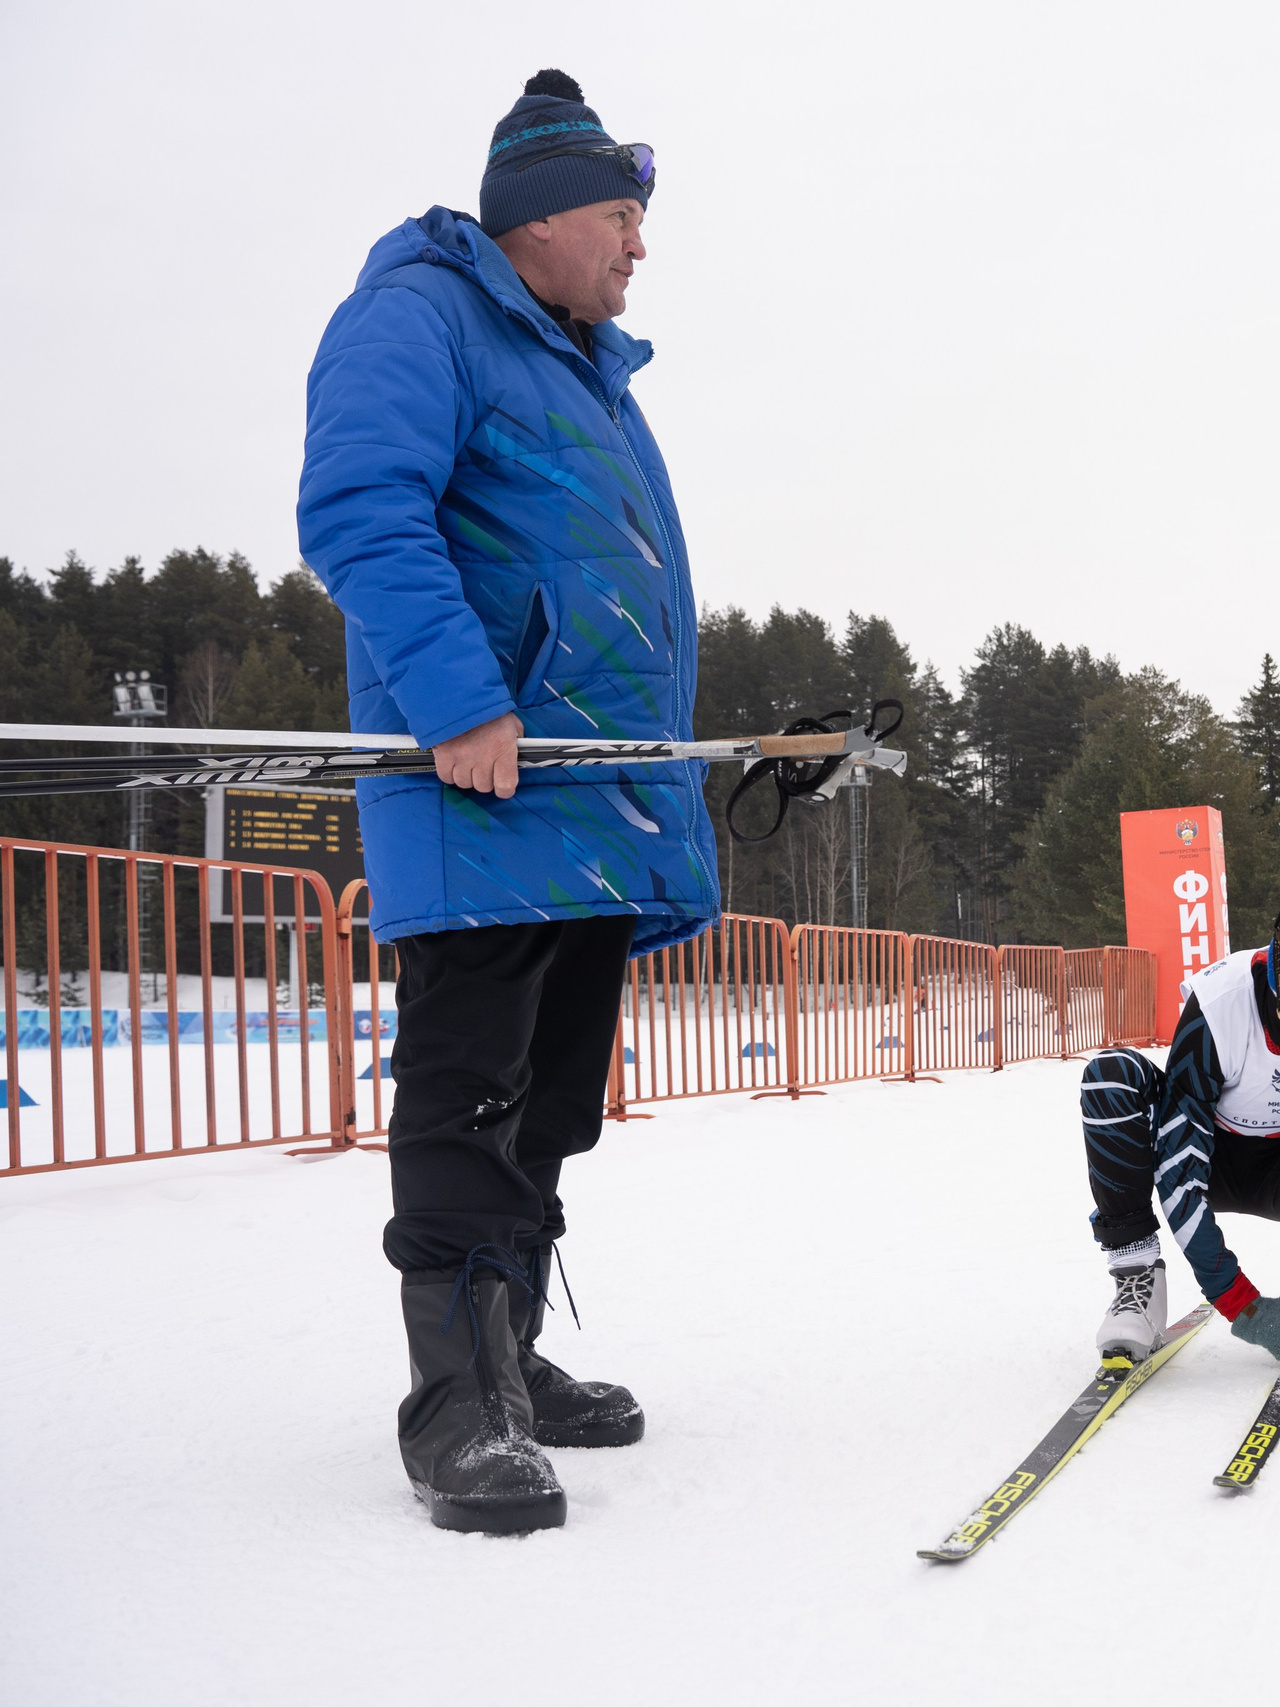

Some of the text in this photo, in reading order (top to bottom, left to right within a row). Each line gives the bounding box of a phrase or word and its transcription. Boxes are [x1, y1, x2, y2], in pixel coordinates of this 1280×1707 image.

[116, 768, 311, 788] SWIX
[1233, 1116, 1277, 1126] СПОРТ
[1125, 1360, 1153, 1397] FISCHER
[1227, 1422, 1277, 1482] FISCHER
